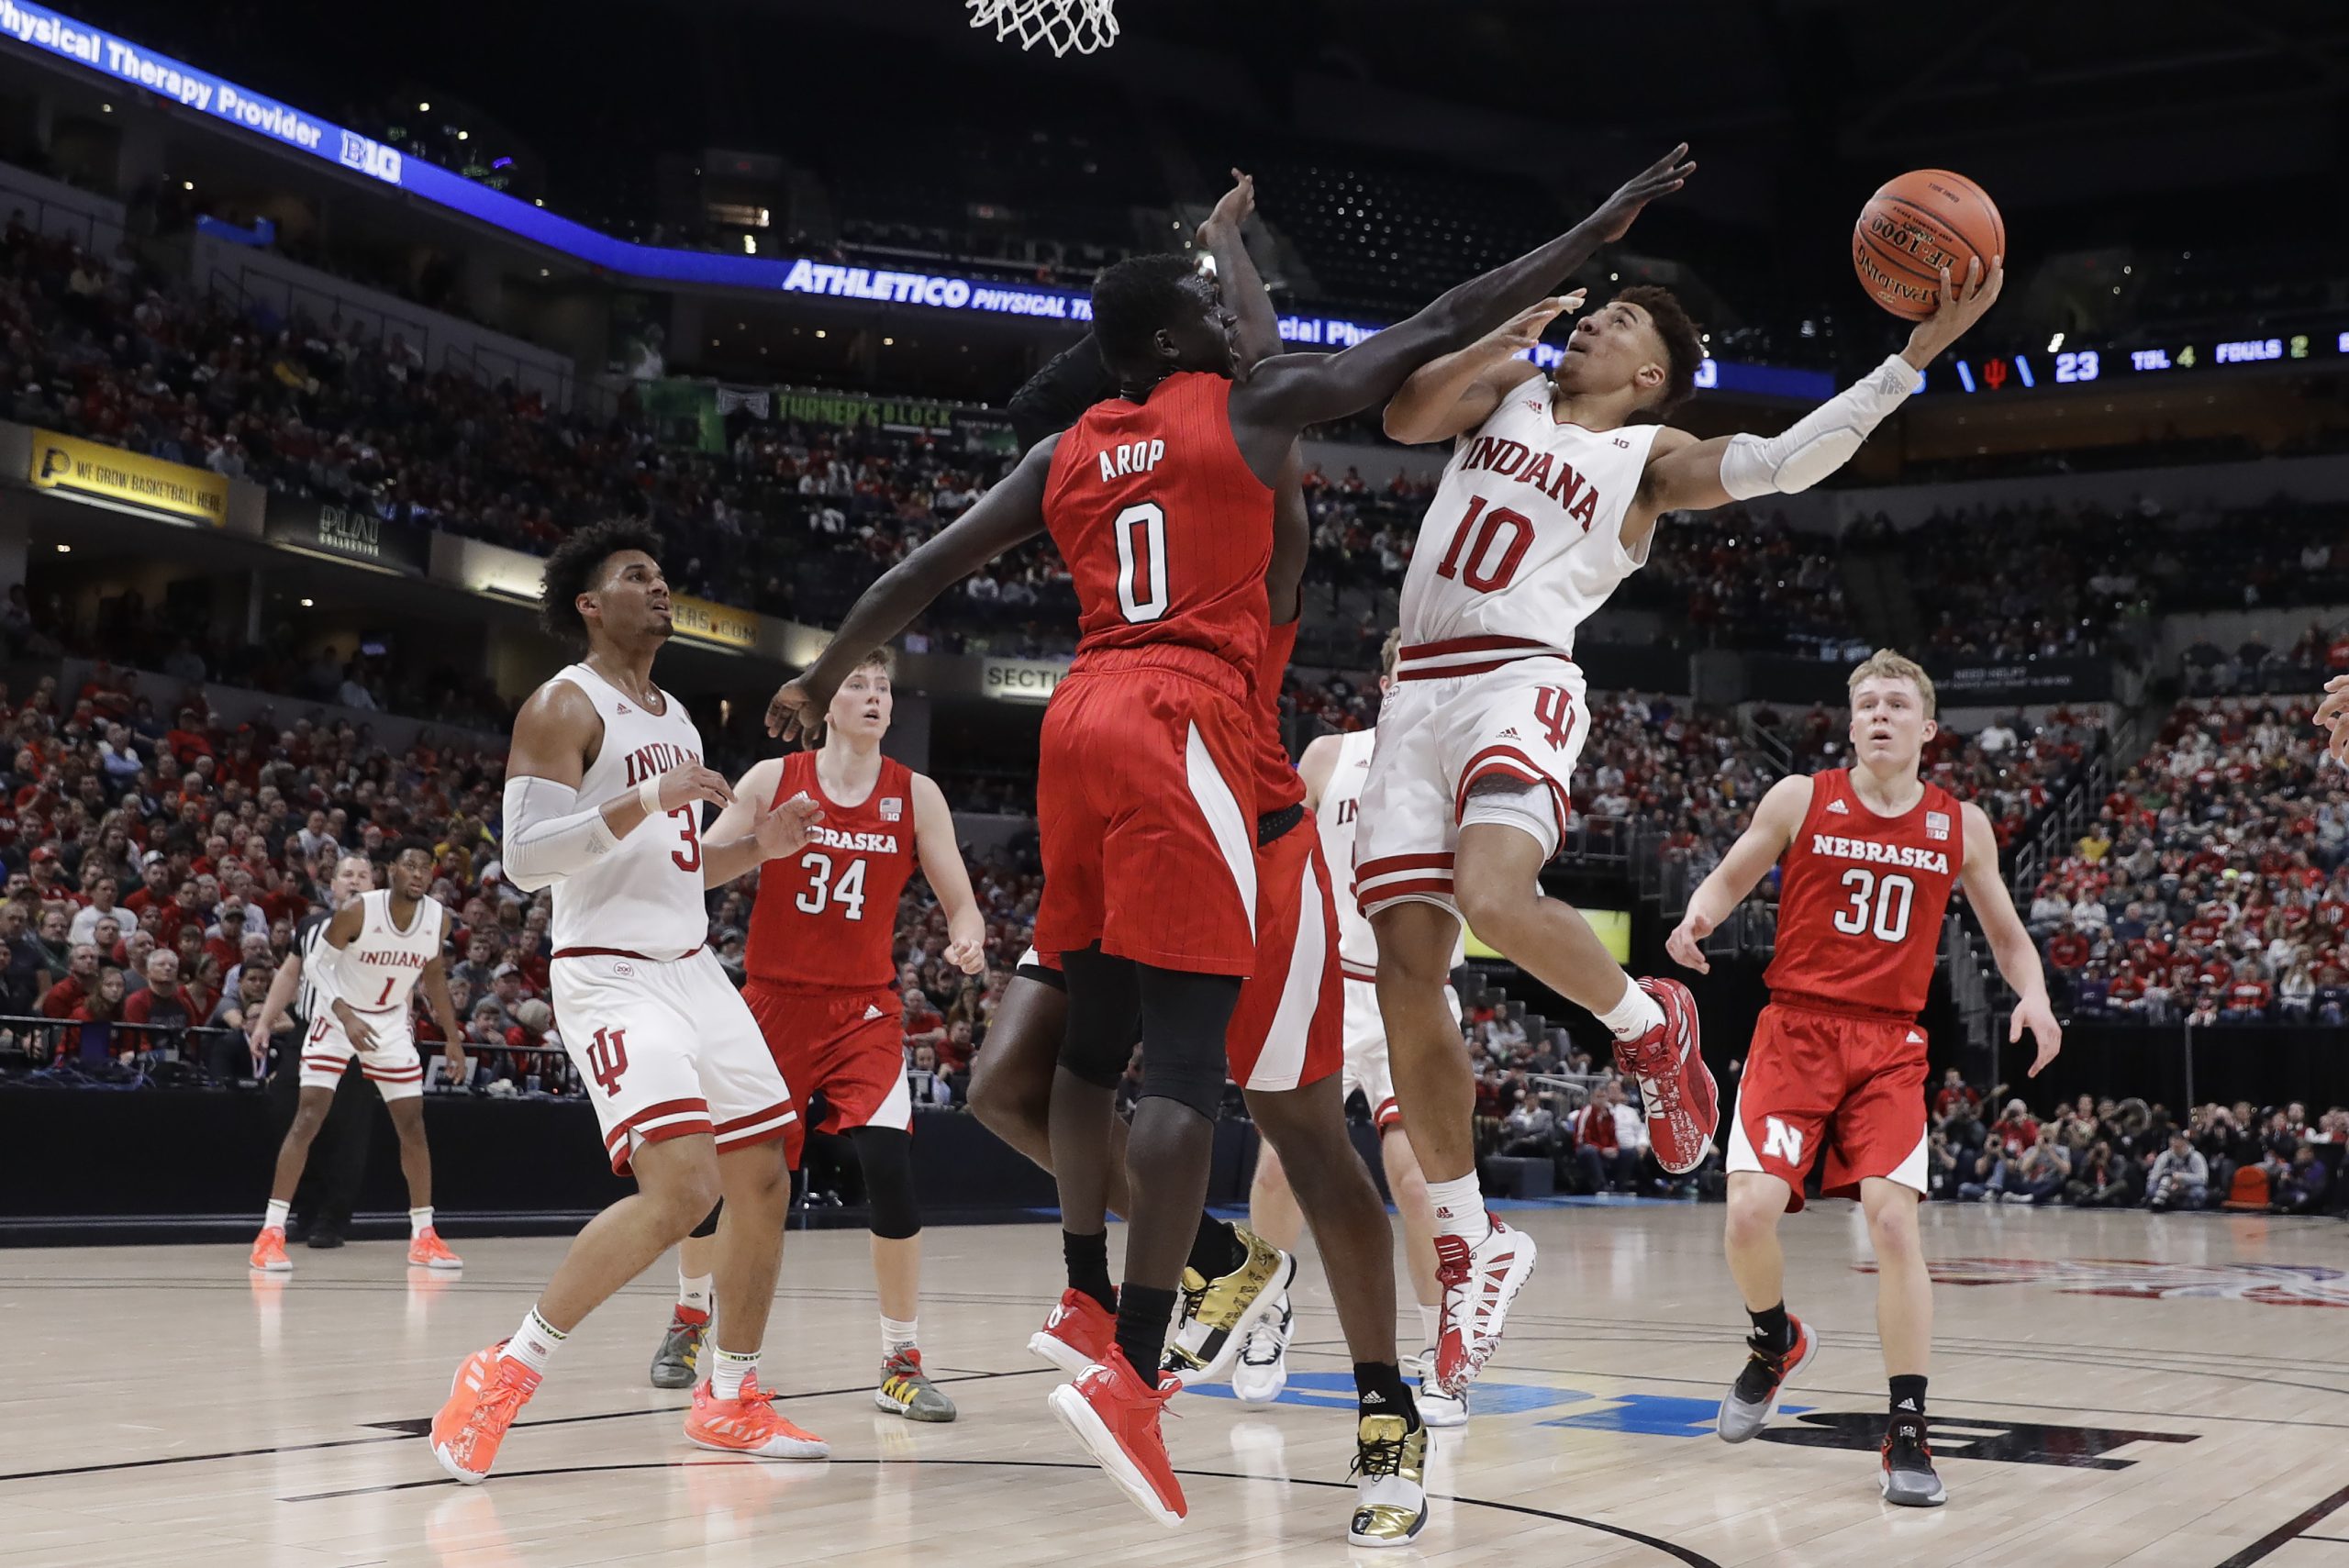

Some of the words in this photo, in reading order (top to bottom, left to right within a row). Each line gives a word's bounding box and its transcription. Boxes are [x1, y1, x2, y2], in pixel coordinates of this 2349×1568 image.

[0, 0, 101, 63] hysical
[106, 39, 212, 110] Therapy
[217, 84, 321, 149] Provider
[971, 288, 1066, 318] PHYSICAL
[1277, 316, 1321, 343] cial
[2055, 350, 2099, 384] 23
[2176, 345, 2197, 368] 4
[2215, 338, 2283, 363] FOULS
[2290, 335, 2309, 359] 2
[883, 402, 952, 427] BLOCK
[1099, 439, 1165, 484] AROP
[1462, 435, 1600, 533] INDIANA
[77, 462, 93, 481] WE
[95, 466, 128, 488] GROW
[132, 475, 194, 504] BASKETBALL
[197, 489, 222, 512] HERE
[1113, 500, 1170, 625] 0
[1437, 495, 1536, 594] 10
[987, 666, 1067, 688] SECTI
[671, 803, 702, 873] 3
[807, 825, 898, 854] BRASKA
[1811, 833, 1949, 874] NEBRASKA
[795, 851, 868, 921] 34
[1833, 867, 1915, 943] 30
[374, 976, 396, 1006] 1
[1761, 1115, 1805, 1167] N
